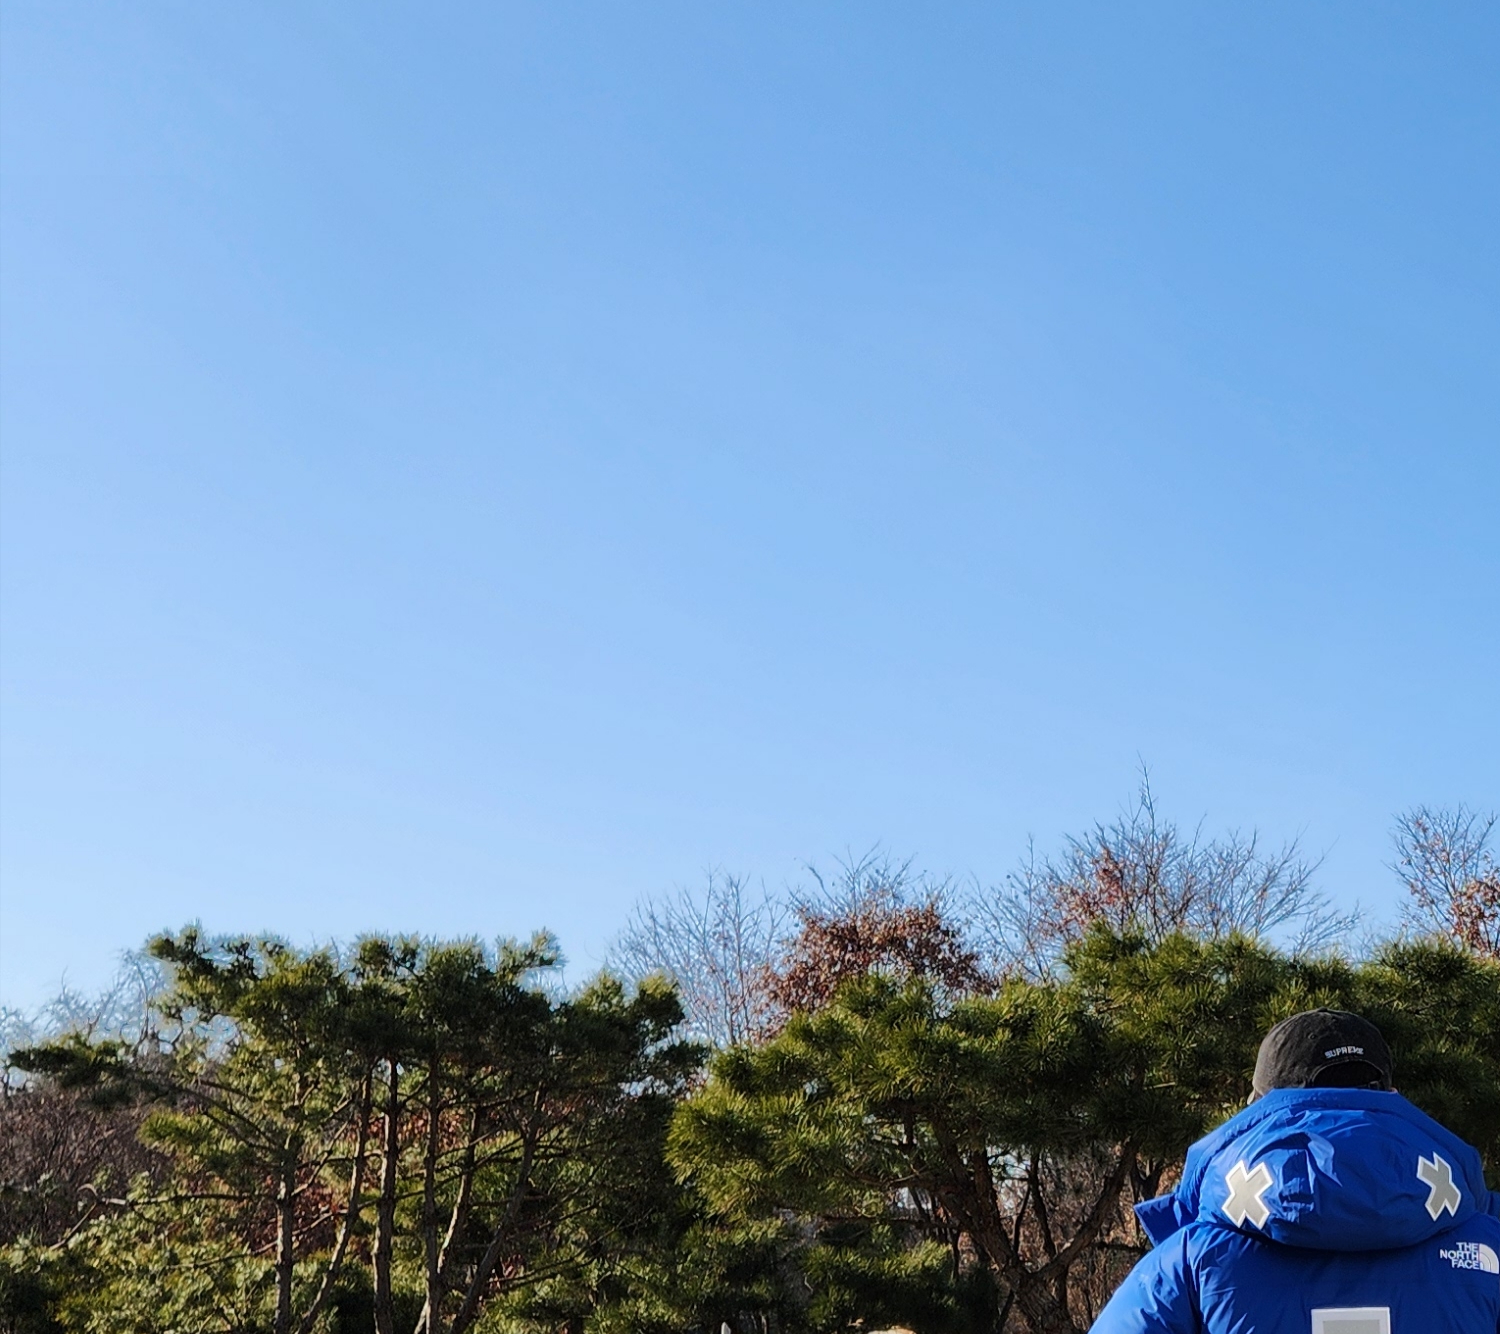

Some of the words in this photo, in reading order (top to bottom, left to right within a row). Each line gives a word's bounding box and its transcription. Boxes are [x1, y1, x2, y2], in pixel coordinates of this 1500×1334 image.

[1324, 1045, 1364, 1059] SUPREME
[1455, 1241, 1480, 1252] THE
[1439, 1248, 1480, 1261] NORTH
[1451, 1259, 1480, 1270] FACE
